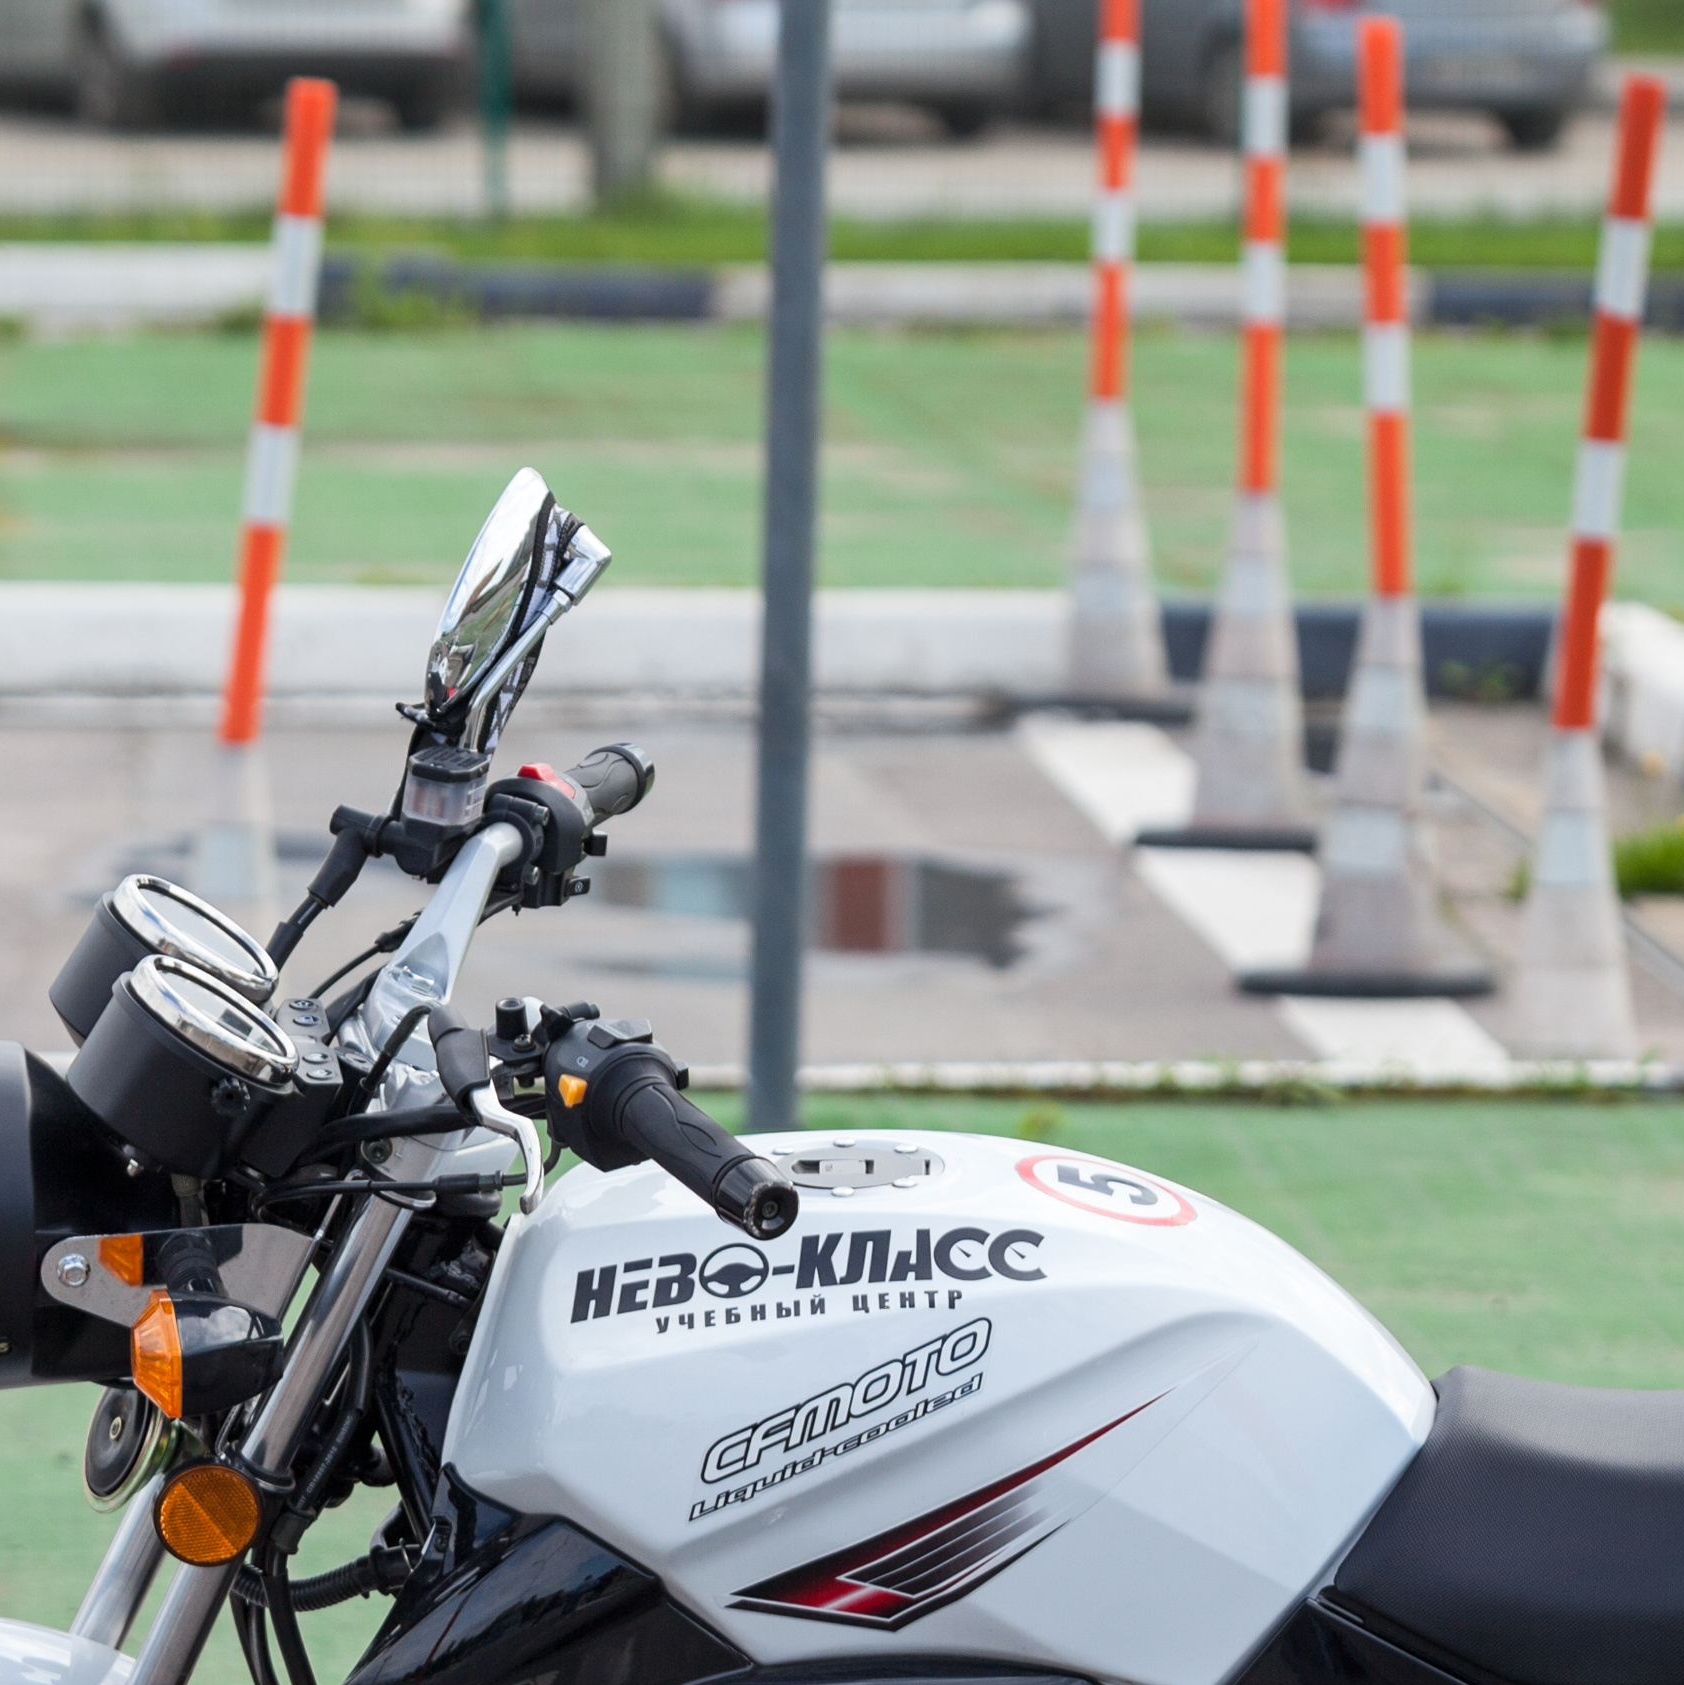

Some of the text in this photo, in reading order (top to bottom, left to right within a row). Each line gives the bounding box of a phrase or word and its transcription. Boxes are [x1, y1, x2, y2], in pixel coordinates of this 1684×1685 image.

[1056, 1164, 1159, 1206] 5
[655, 1289, 964, 1334] УЧЕБНЫЙ ЦЕНТР
[700, 1316, 993, 1485] CFMOTO
